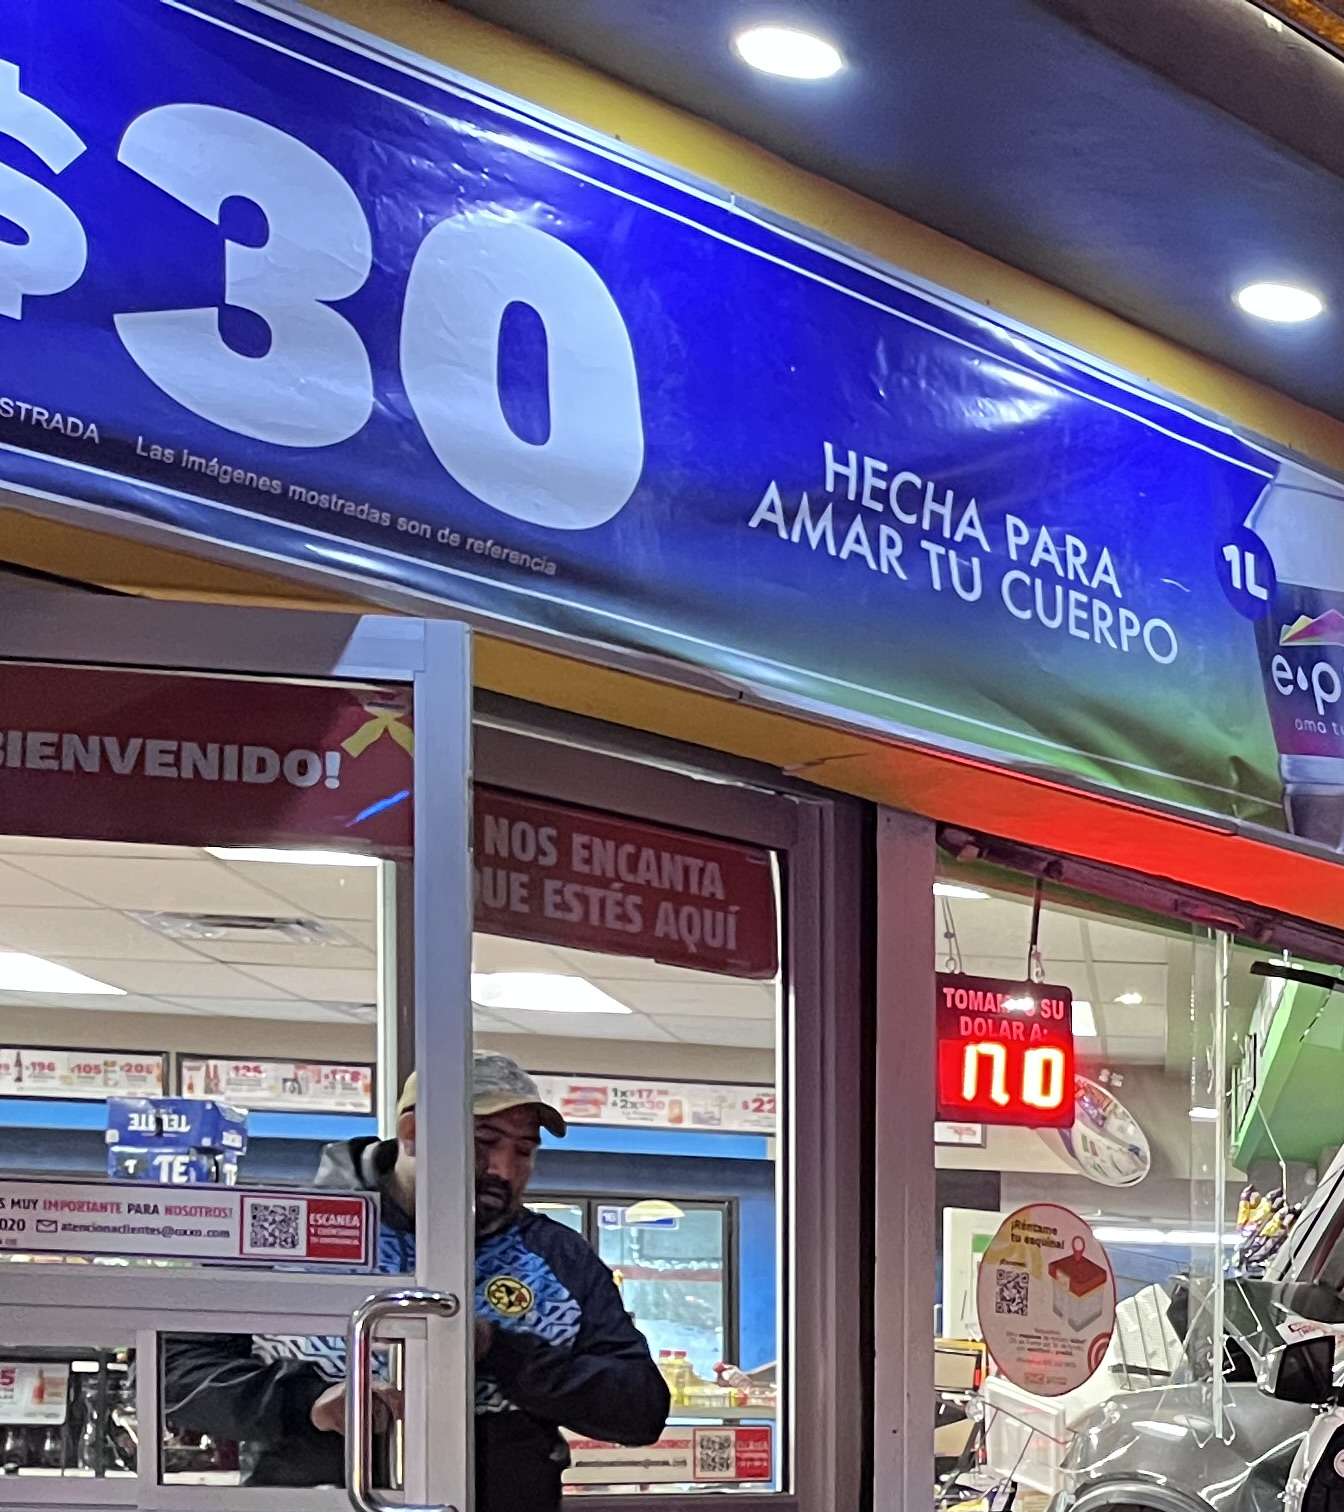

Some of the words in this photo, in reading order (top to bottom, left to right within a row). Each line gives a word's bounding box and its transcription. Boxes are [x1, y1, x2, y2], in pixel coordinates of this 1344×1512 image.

[135, 436, 175, 464] Las
[288, 484, 391, 527] mostradas
[396, 516, 431, 539] son
[436, 527, 460, 547] de
[465, 536, 558, 576] referencia
[823, 441, 991, 553] HECHA
[1005, 513, 1123, 598] PARA
[749, 480, 907, 580] AMAR
[920, 540, 983, 602] TU
[1000, 569, 1179, 665] CUERPO
[1221, 544, 1269, 601] 1L
[0, 729, 341, 790] IENVENIDO!
[483, 814, 557, 867] NOS
[571, 832, 725, 900] ENCANTA
[543, 881, 643, 934] ESTÉS
[653, 901, 740, 953] AQUÍ
[959, 1015, 1026, 1041] DOLAR
[1039, 998, 1065, 1020] SU
[11, 1198, 39, 1211] MUY
[43, 1199, 123, 1215] IMPORTANTE
[127, 1202, 160, 1216] PARA
